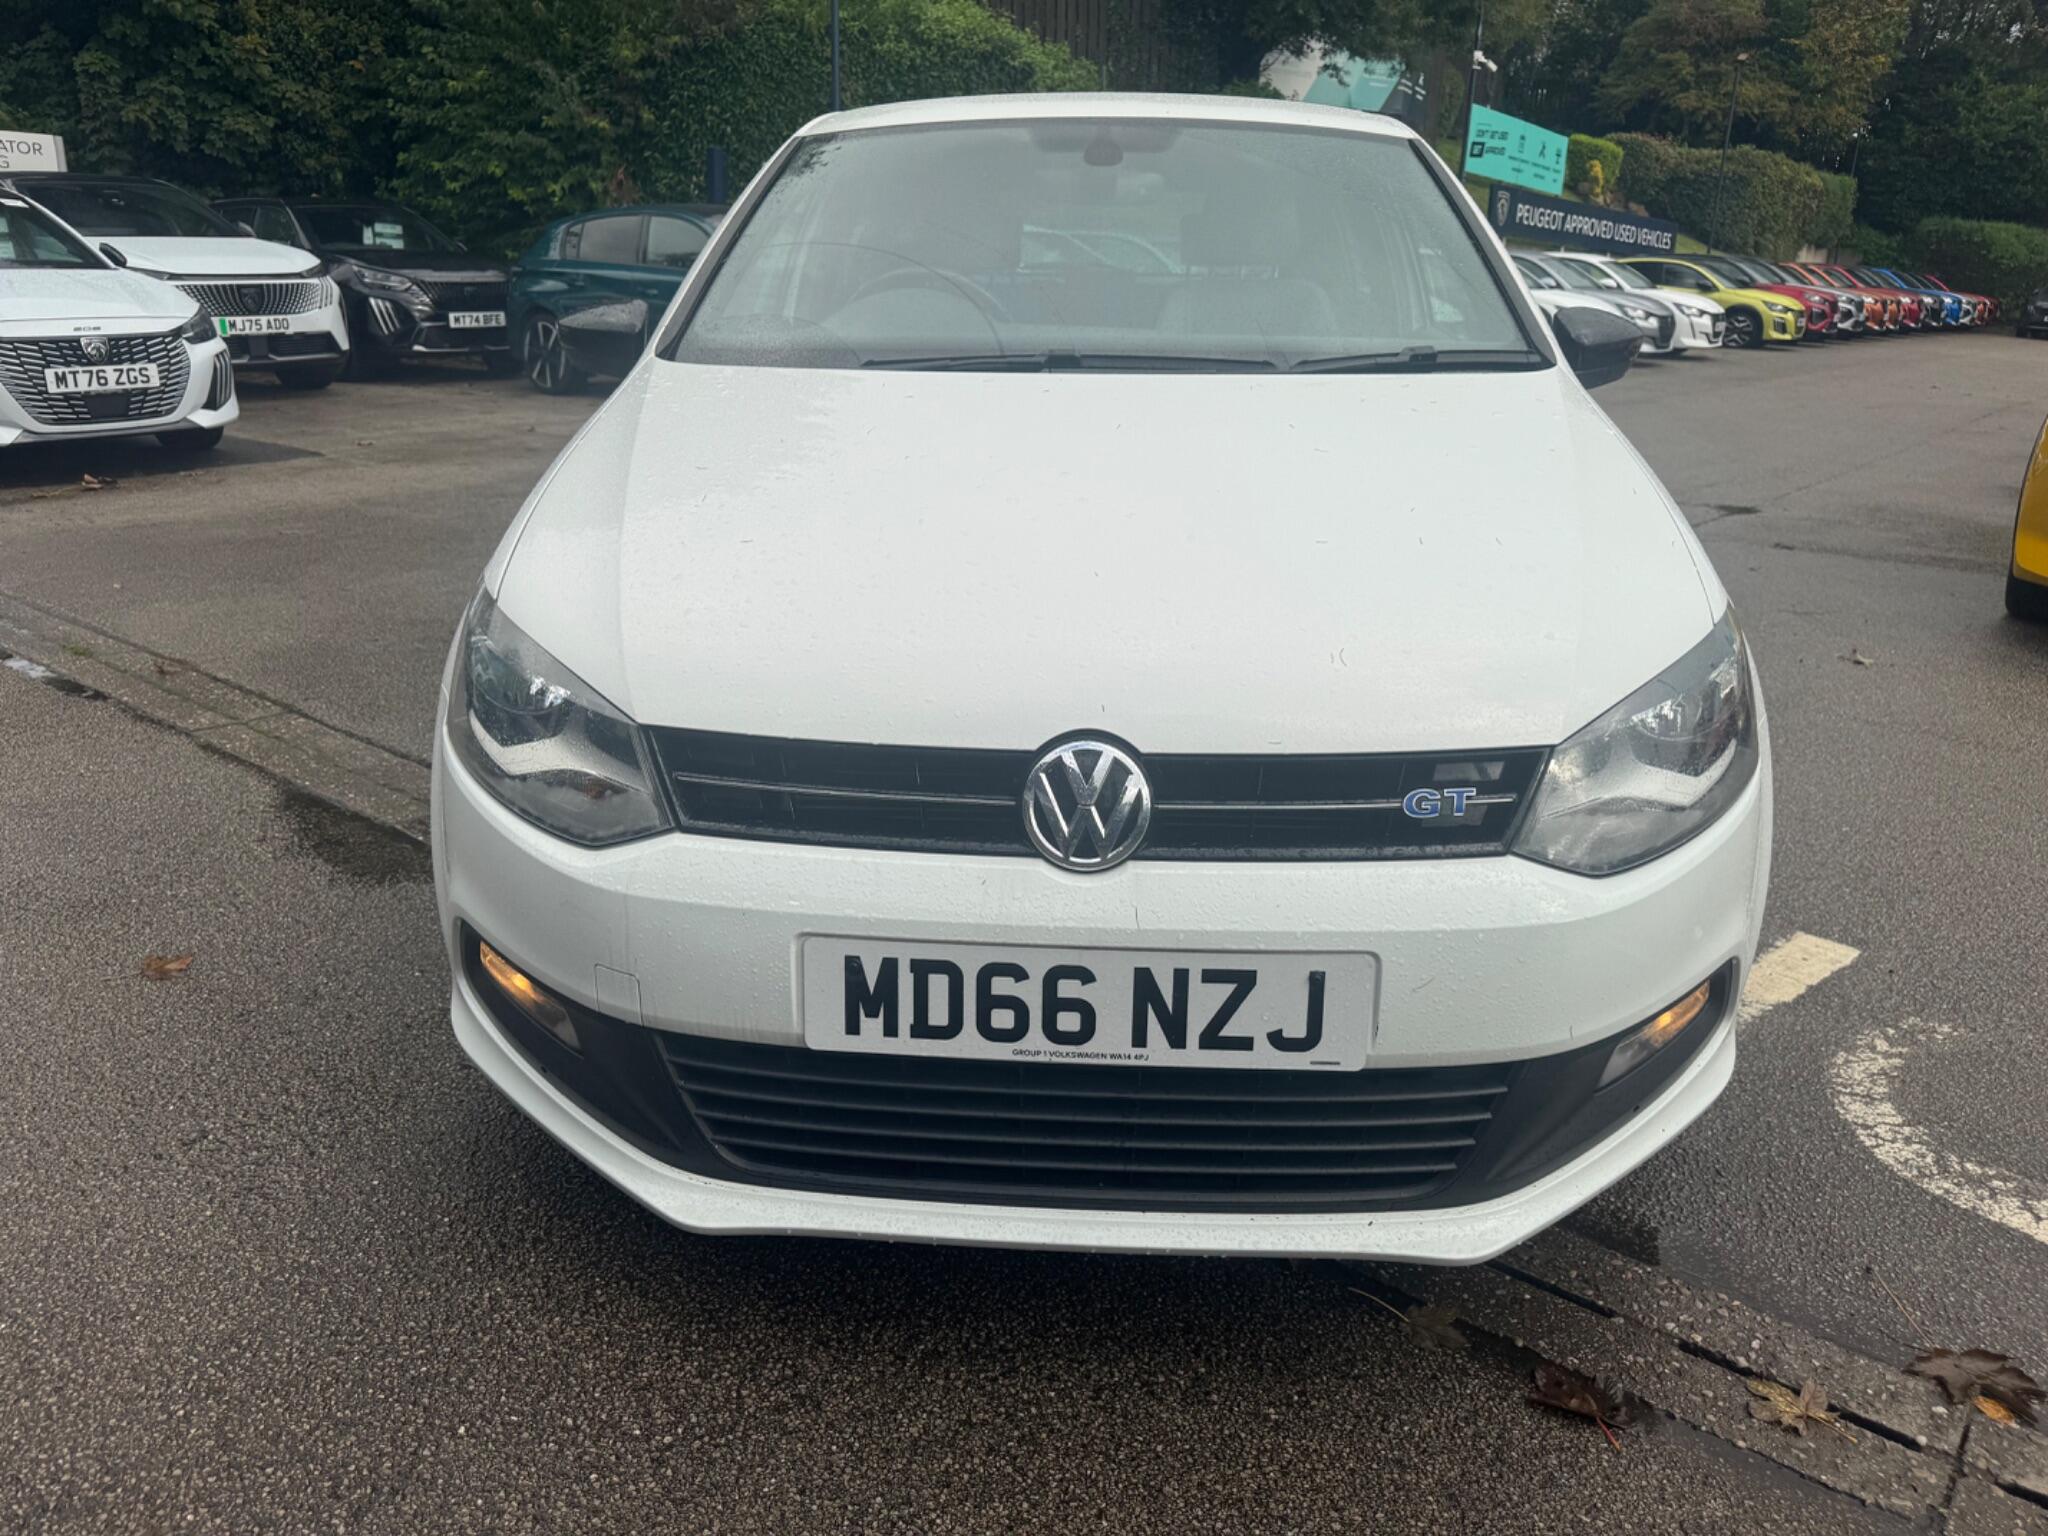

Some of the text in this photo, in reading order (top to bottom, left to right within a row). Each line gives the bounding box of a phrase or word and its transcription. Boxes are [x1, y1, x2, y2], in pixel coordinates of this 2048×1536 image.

[1516, 203, 1673, 249] PEUGEOT APPROVED USED VEHICLES
[228, 318, 262, 332] MJ75
[453, 314, 480, 326] MT74
[54, 366, 150, 389] MT76 ZGS
[1402, 787, 1476, 818] GT
[844, 955, 1326, 1053] MD66 NZJ
[1012, 1048, 1042, 1057] GROUP
[1048, 1050, 1107, 1060] VOLKSWAGEN
[1109, 1053, 1132, 1061] WA14
[1133, 1054, 1150, 1062] 4PJ
